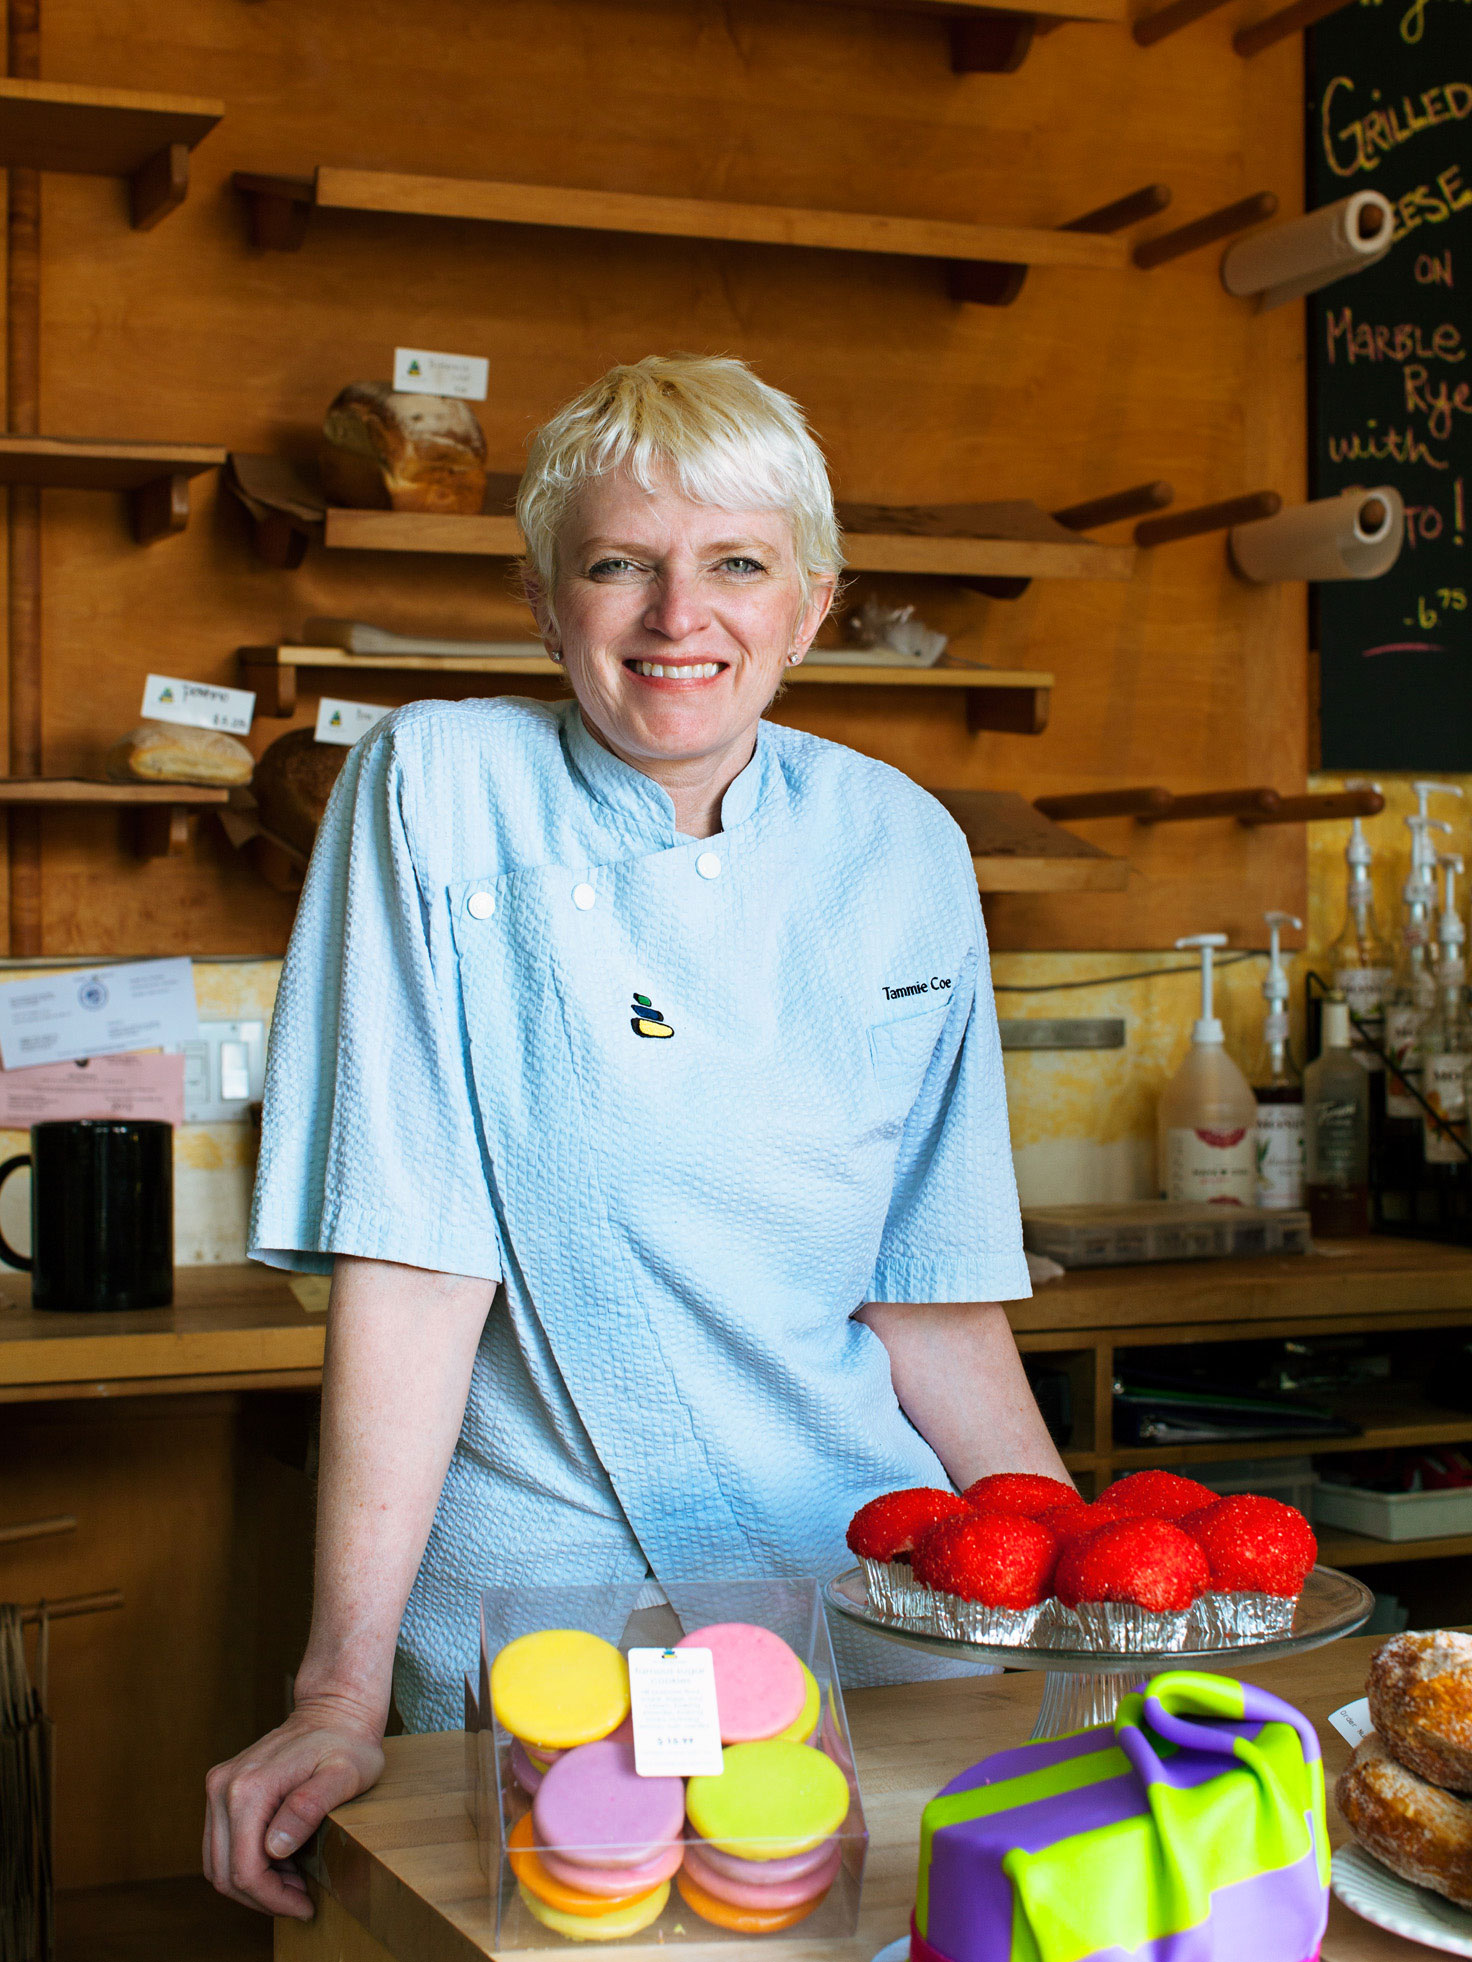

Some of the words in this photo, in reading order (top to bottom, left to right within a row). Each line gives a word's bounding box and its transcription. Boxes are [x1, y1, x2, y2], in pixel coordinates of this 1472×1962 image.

[1404, 364, 1472, 440] Rye
[1329, 419, 1449, 469] with
[882, 981, 928, 1000] Tammie
[930, 976, 952, 990] Coe
[1340, 1710, 1357, 1727] Order
